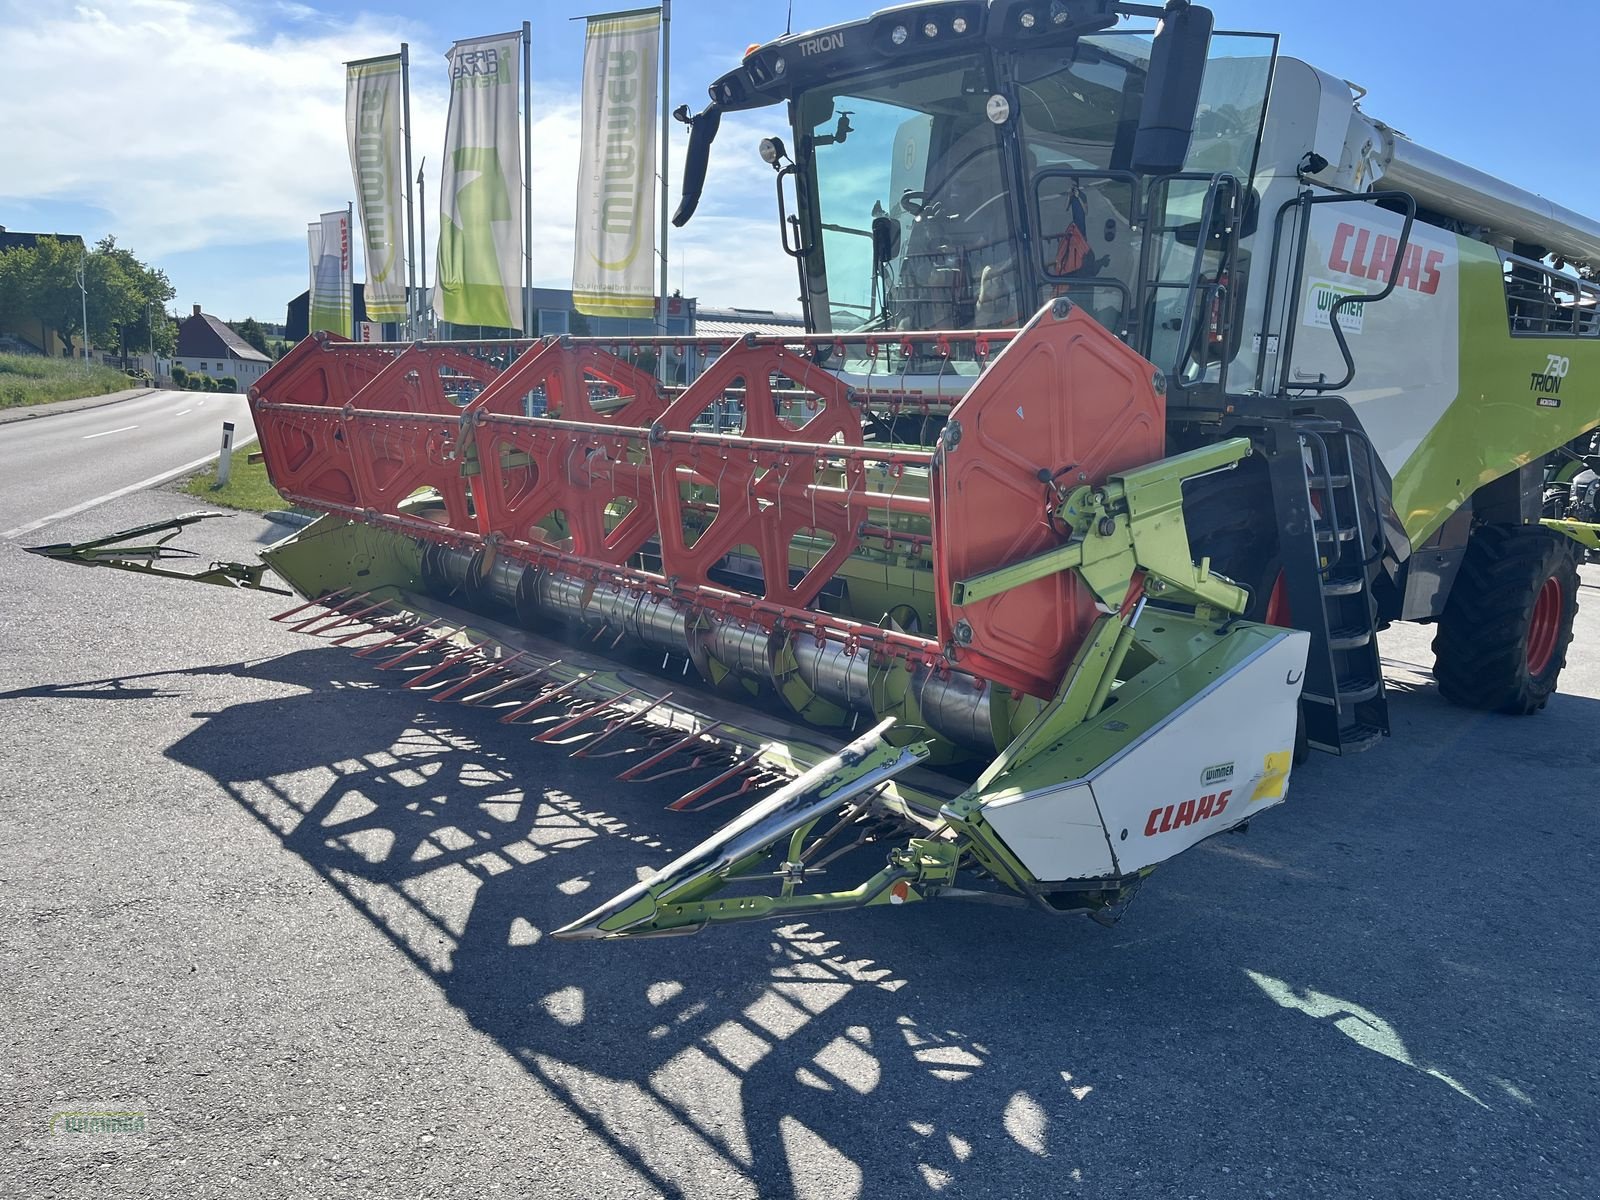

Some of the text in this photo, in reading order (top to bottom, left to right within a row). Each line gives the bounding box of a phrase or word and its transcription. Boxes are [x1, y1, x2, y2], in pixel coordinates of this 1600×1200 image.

[798, 32, 845, 57] TRION
[1328, 222, 1445, 295] CLAAS
[1544, 353, 1570, 378] 730
[1530, 372, 1562, 394] TRION
[1206, 765, 1234, 781] WIMMER
[1144, 789, 1232, 836] CLAAS
